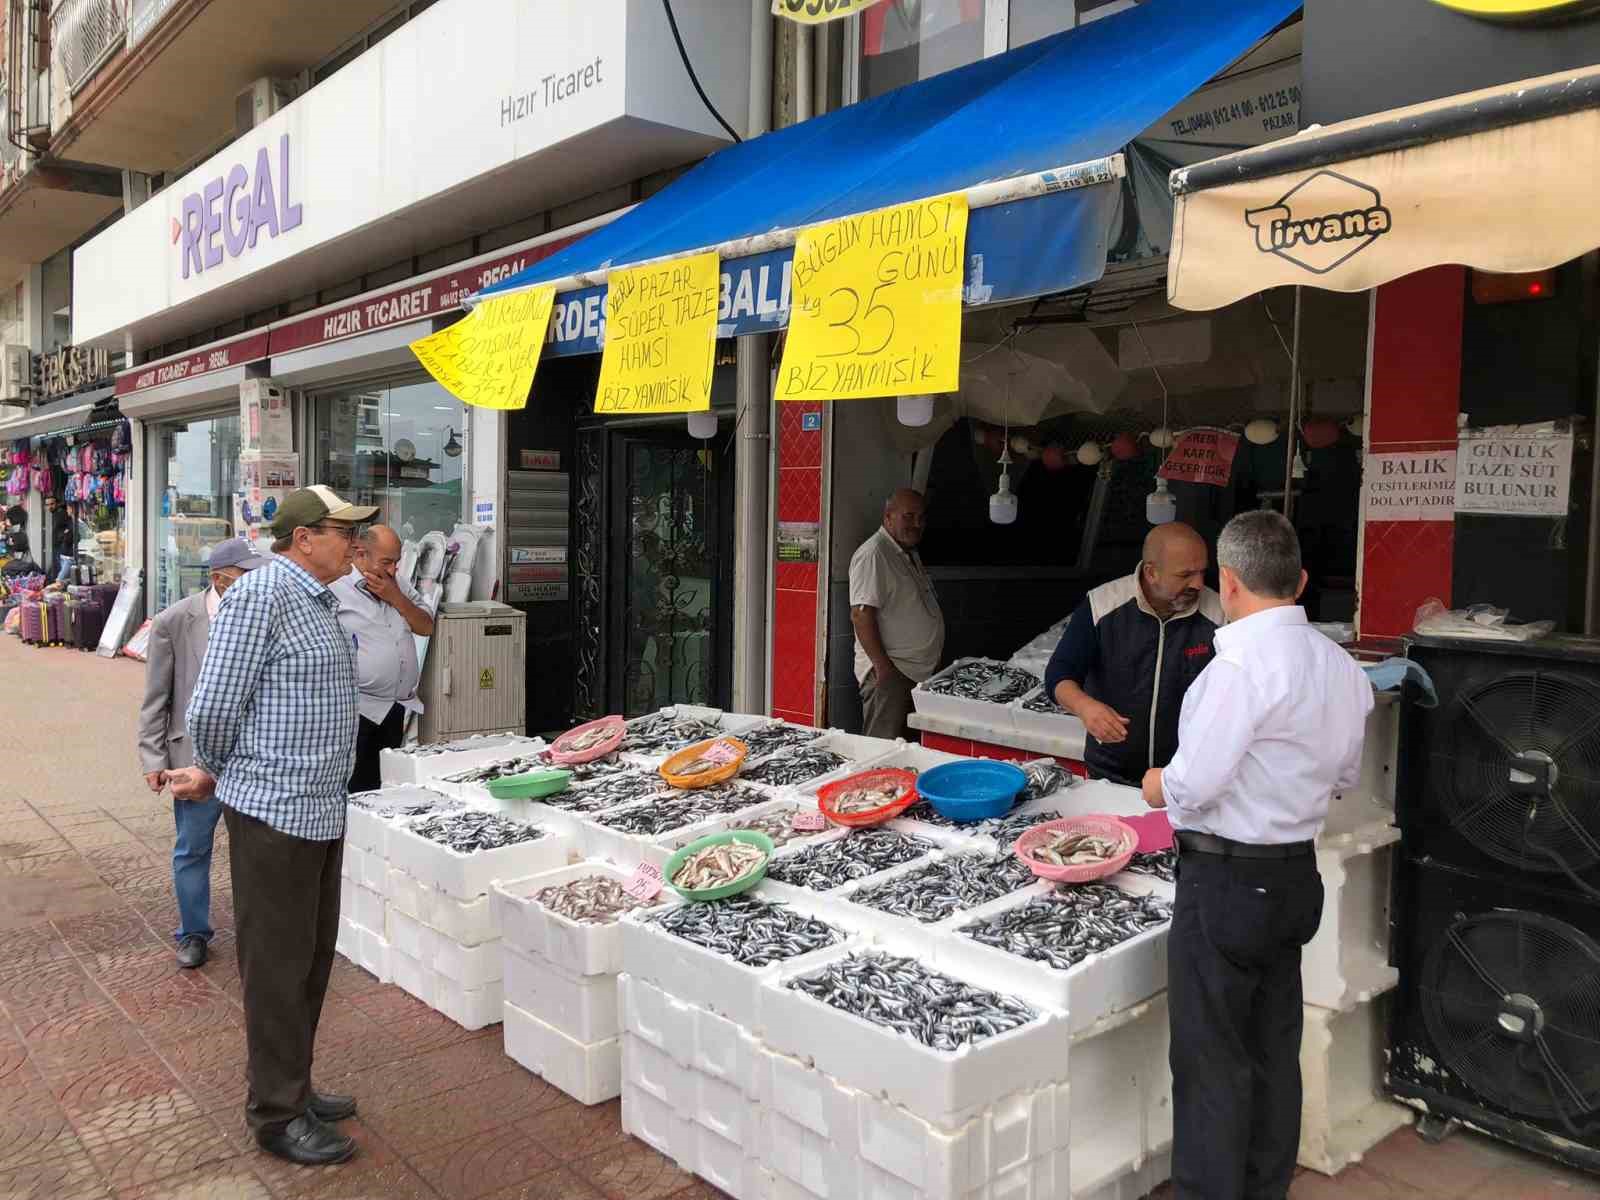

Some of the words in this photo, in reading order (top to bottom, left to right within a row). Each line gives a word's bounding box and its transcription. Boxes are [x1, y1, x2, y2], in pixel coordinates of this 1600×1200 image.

[500, 95, 536, 128] Hızır
[541, 55, 602, 107] Ticaret
[182, 133, 302, 279] REGAL
[1245, 204, 1391, 252] Tirvana
[639, 265, 697, 302] PAZAR
[672, 288, 715, 326] TAZE
[816, 282, 896, 358] 35
[324, 310, 361, 339] HIZIR
[808, 416, 815, 427] 2
[1472, 442, 1557, 458] GÜNLÜK
[1382, 458, 1447, 476] BALIK
[1467, 463, 1515, 477] TAZE
[1519, 461, 1560, 479] SÜT
[1370, 495, 1455, 507] DOLAPTADIR
[1464, 482, 1558, 498] BULUNUR
